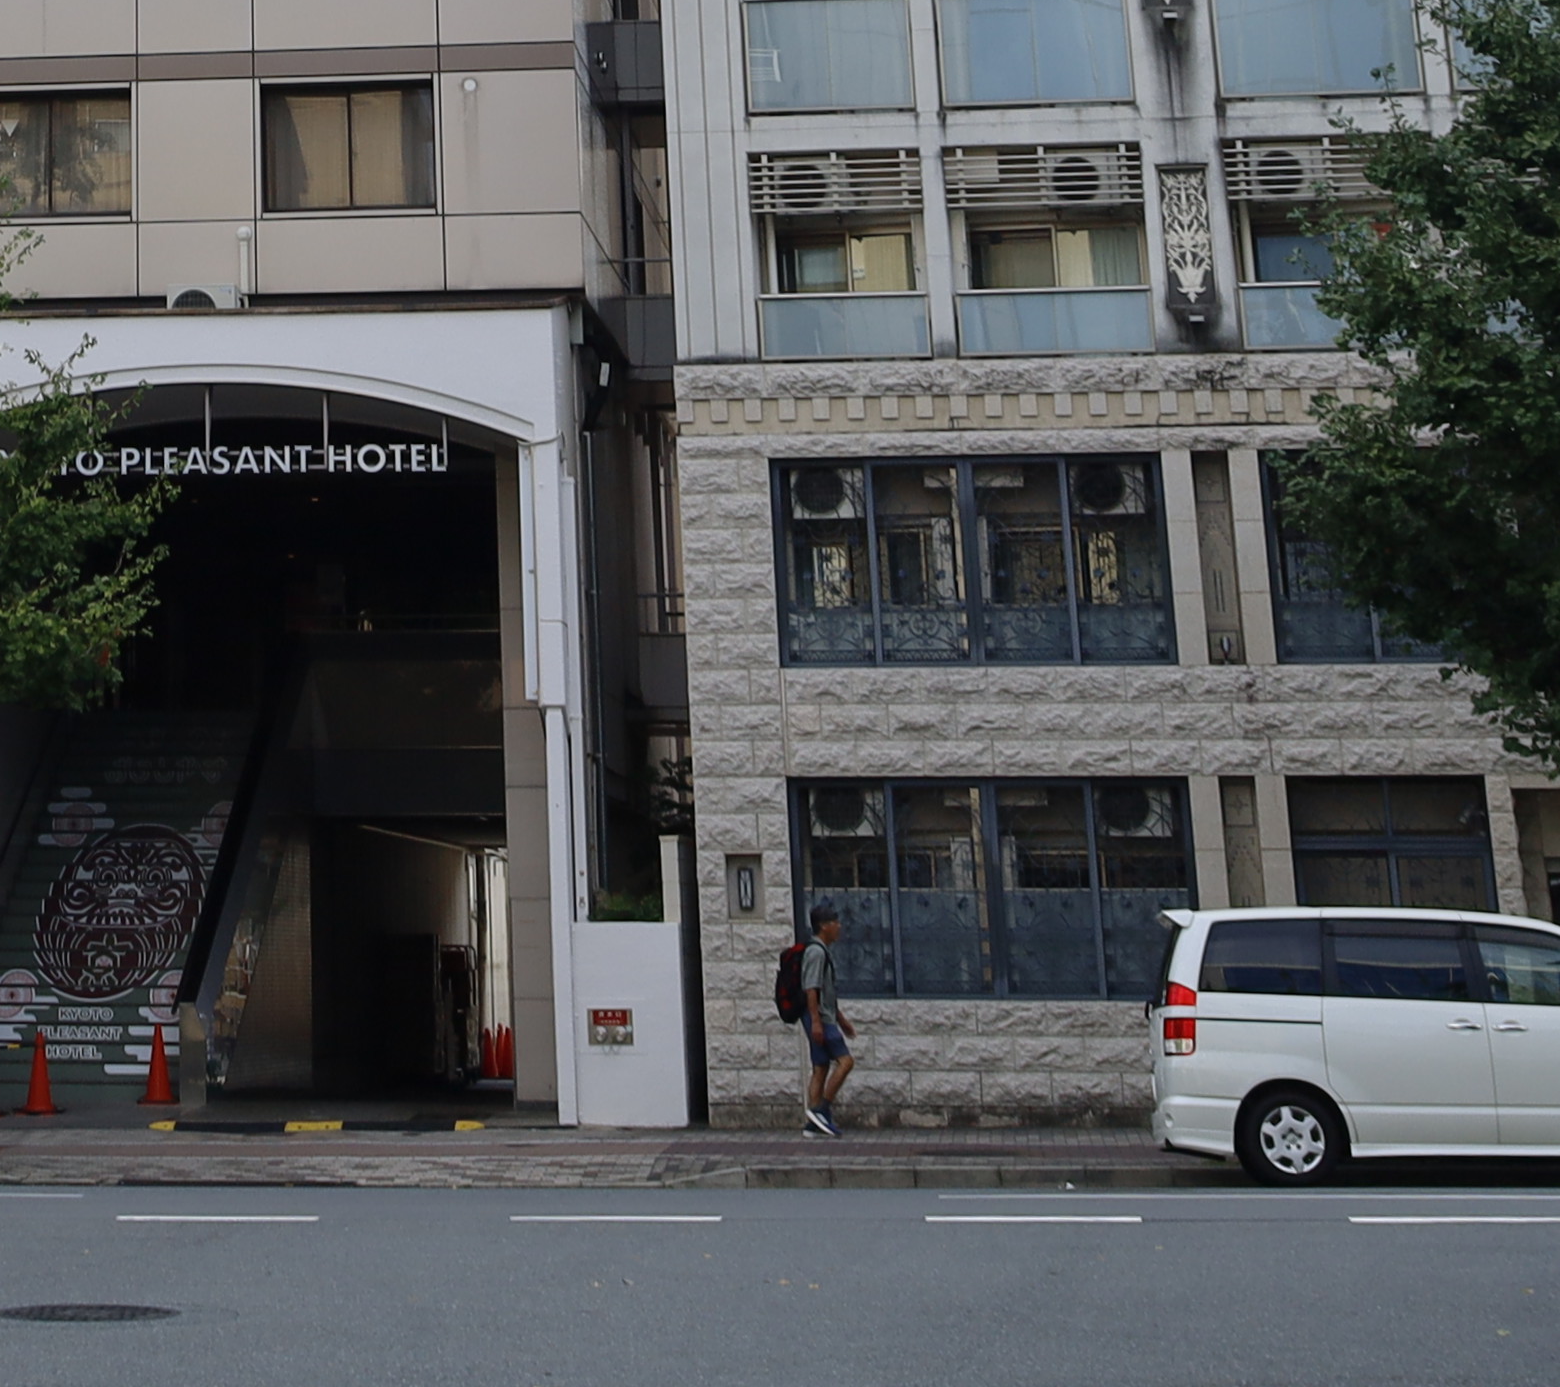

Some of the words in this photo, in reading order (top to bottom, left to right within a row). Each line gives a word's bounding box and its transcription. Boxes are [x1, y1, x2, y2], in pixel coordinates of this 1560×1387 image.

[120, 444, 313, 476] PLEASANT
[327, 442, 448, 474] HOTEL
[58, 1006, 114, 1021] KYOTO
[45, 1044, 103, 1060] HOTEL
